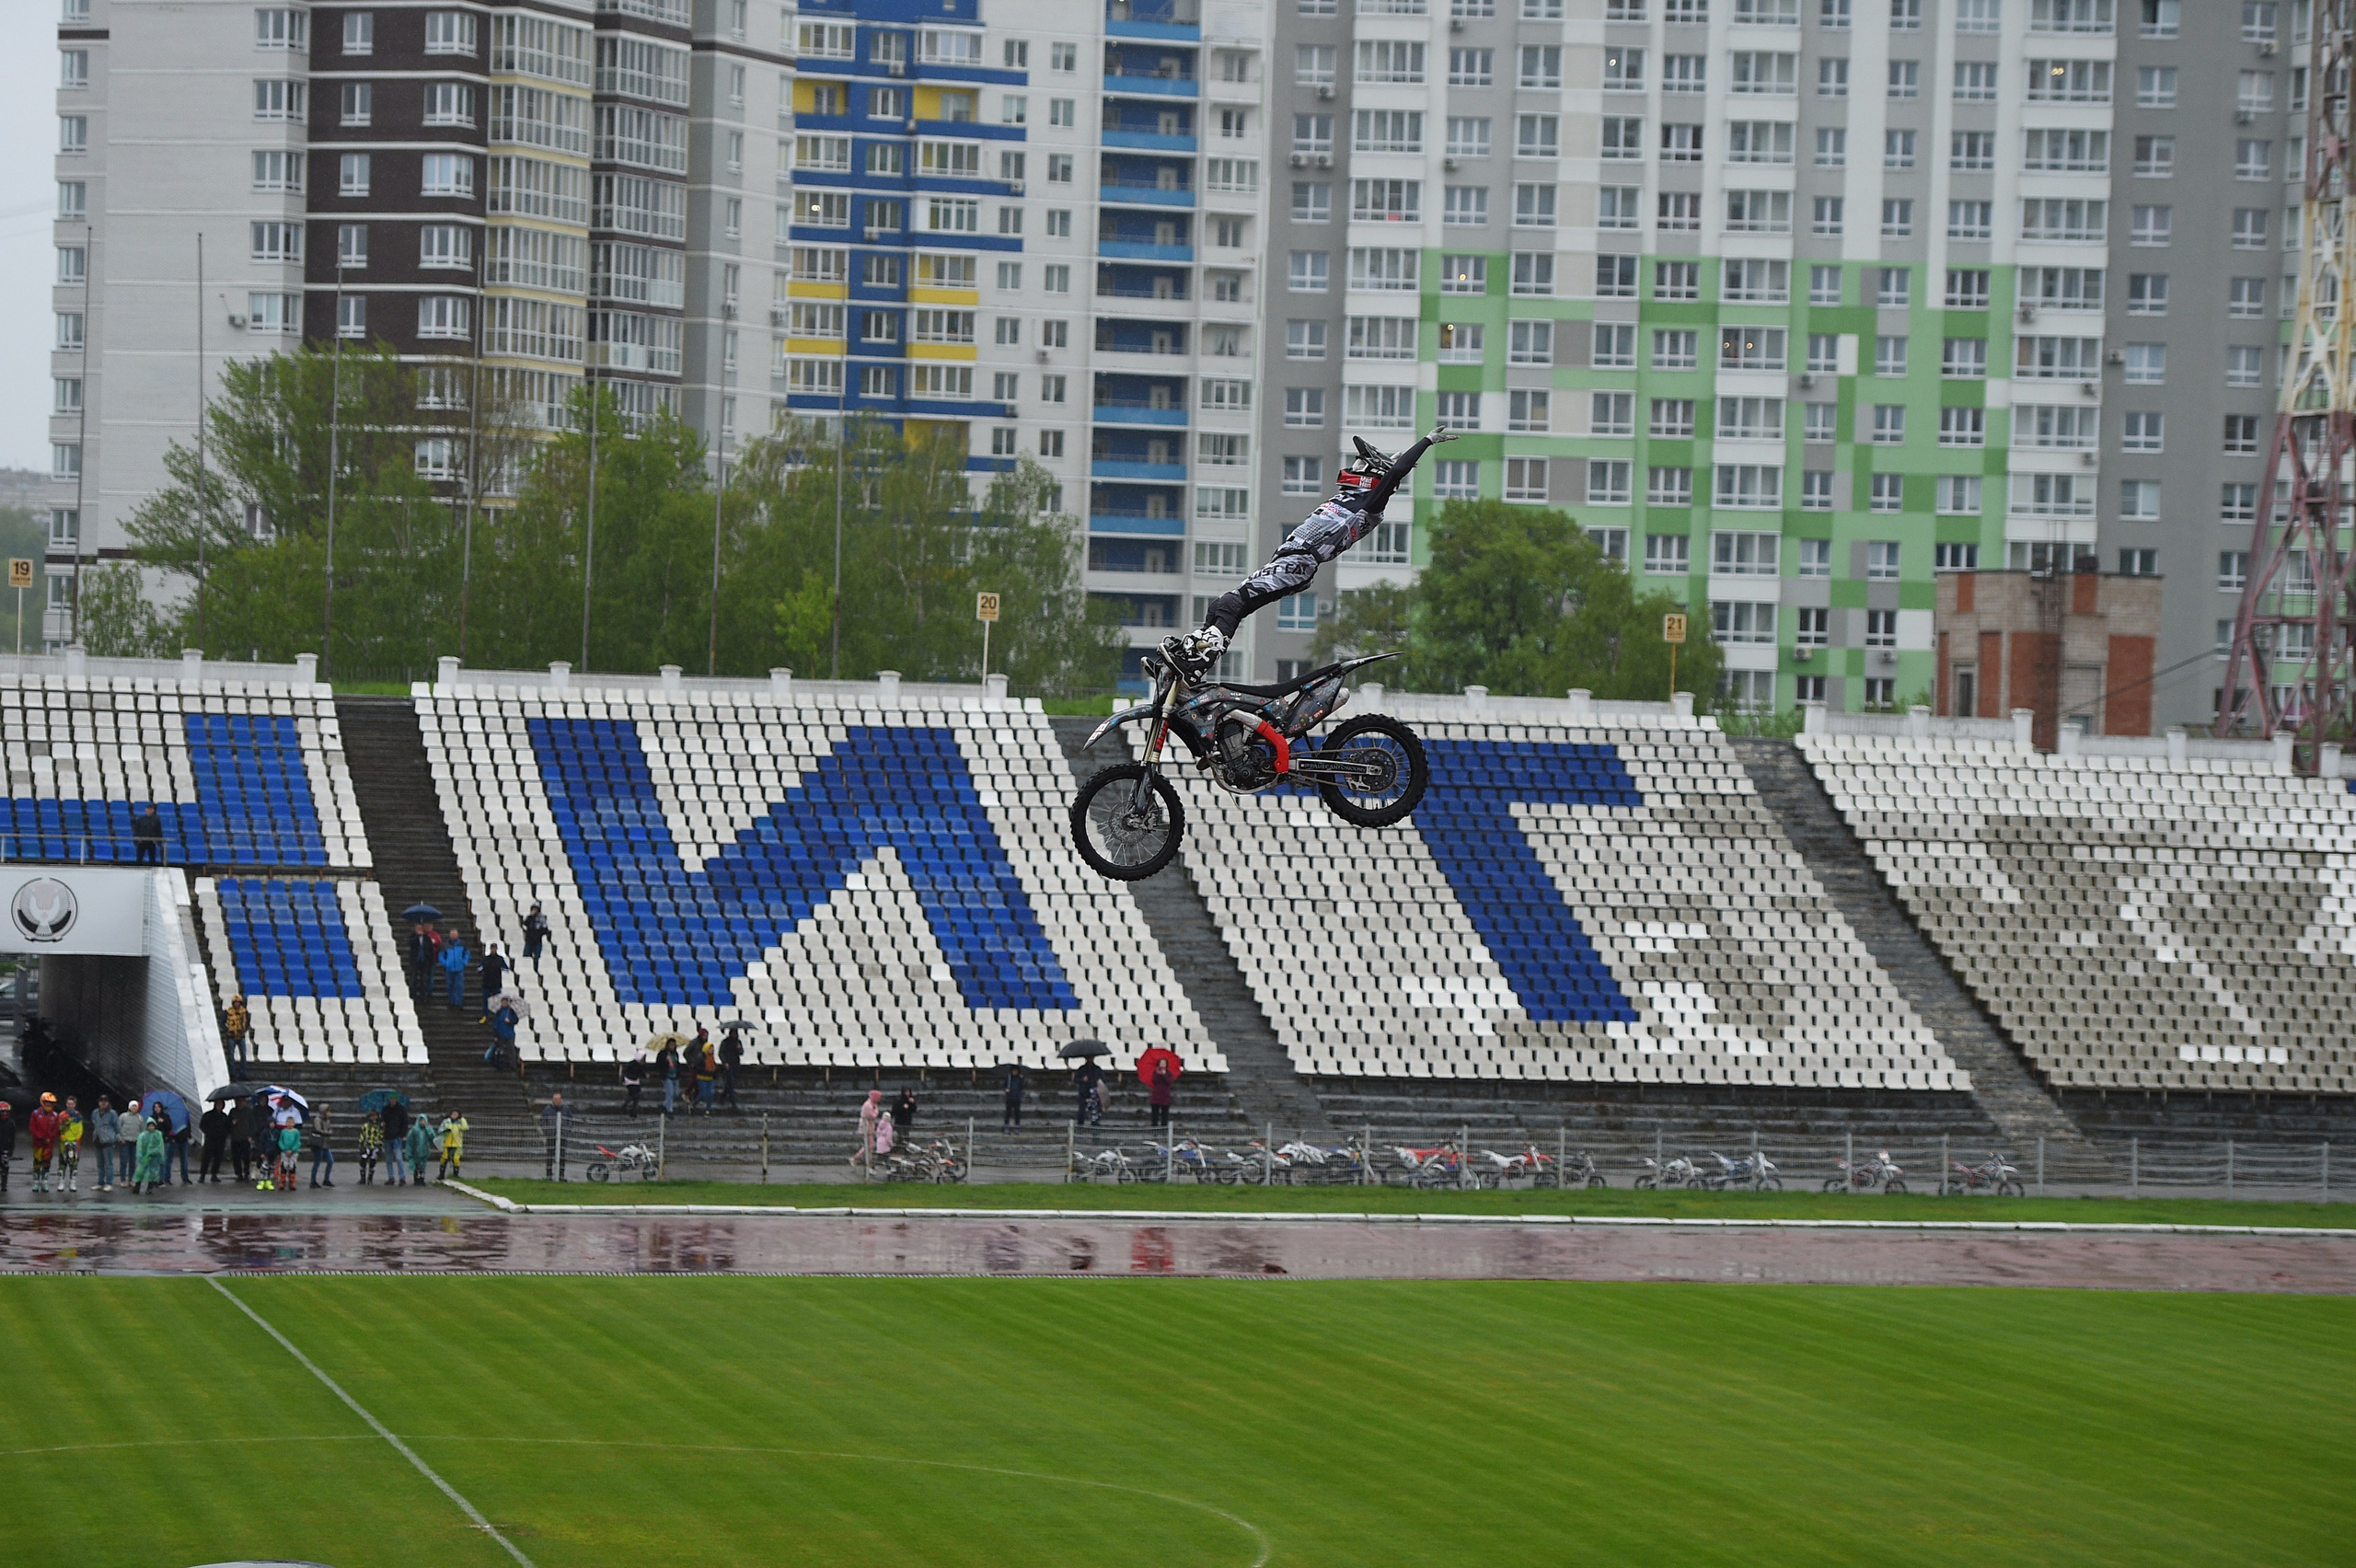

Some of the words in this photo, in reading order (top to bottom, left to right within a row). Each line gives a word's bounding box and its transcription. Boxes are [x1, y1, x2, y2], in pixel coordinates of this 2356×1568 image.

[13, 561, 29, 575] 19
[981, 595, 997, 609] 20
[1668, 617, 1682, 629] 21
